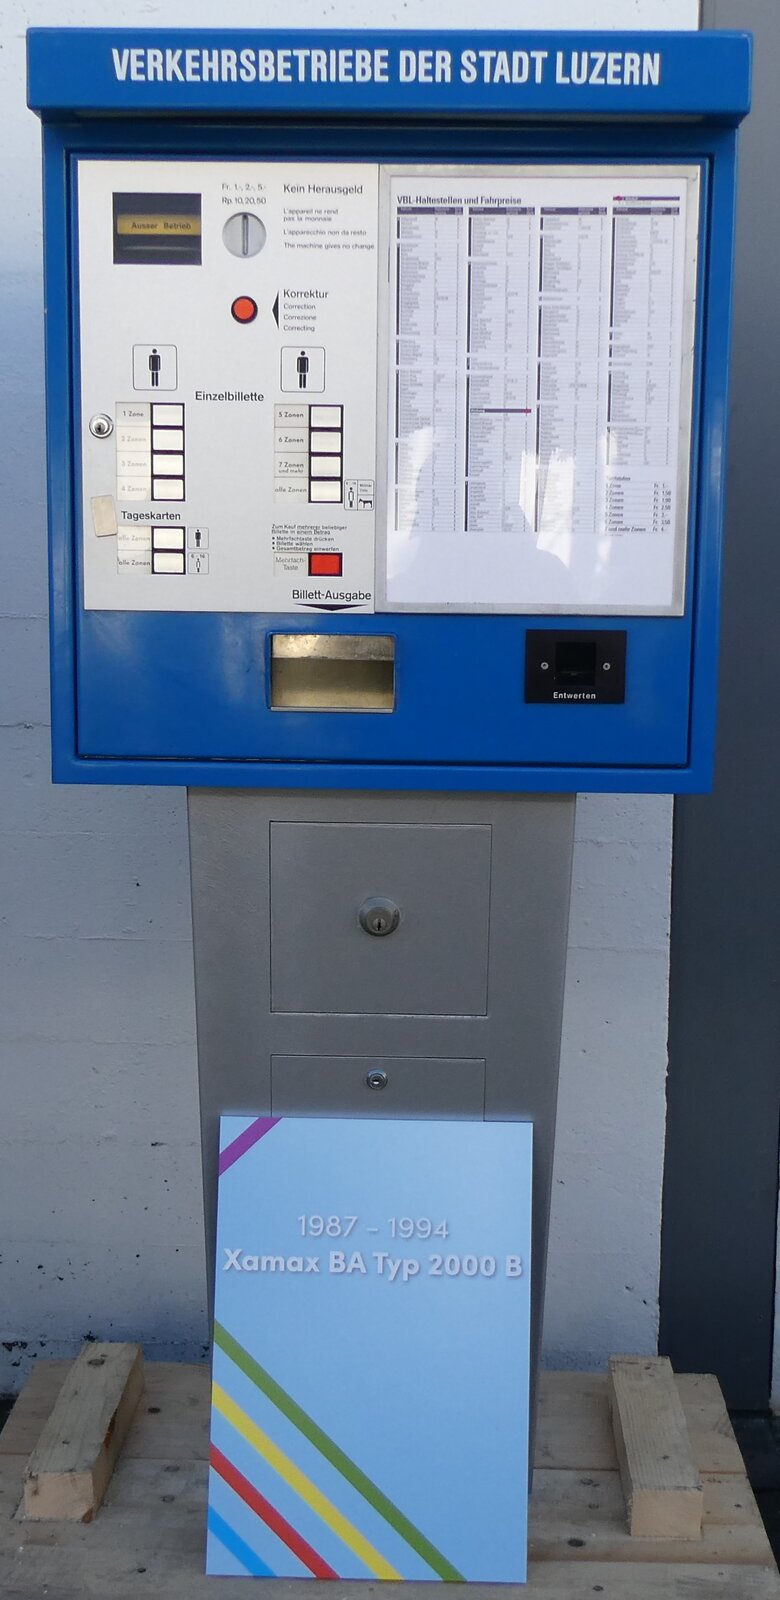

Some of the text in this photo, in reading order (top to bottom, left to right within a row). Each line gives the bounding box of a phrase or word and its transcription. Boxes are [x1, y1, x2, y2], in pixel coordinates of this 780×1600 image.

[111, 48, 660, 86] VERKEHRSBETRIEBE DER STADT LUZERN
[222, 183, 231, 191] Fr.
[283, 184, 364, 196] Kein Herausgeld
[222, 196, 233, 205] Rp.
[396, 196, 522, 207] VBL-Haltestellen und Fahrpreise
[283, 208, 313, 216] L'appareil
[132, 222, 192, 230] Ausser Betrieb
[283, 288, 329, 299] Korrektur
[194, 390, 264, 402] Einzelbillette
[121, 510, 181, 521] Tageskarten
[292, 589, 372, 602] Billett-Ausgabe
[553, 691, 596, 699] Entwerten
[297, 1214, 360, 1238] 1987
[387, 1216, 450, 1239] 1994
[222, 1248, 523, 1281] Xamax BA Typ 2000 B
